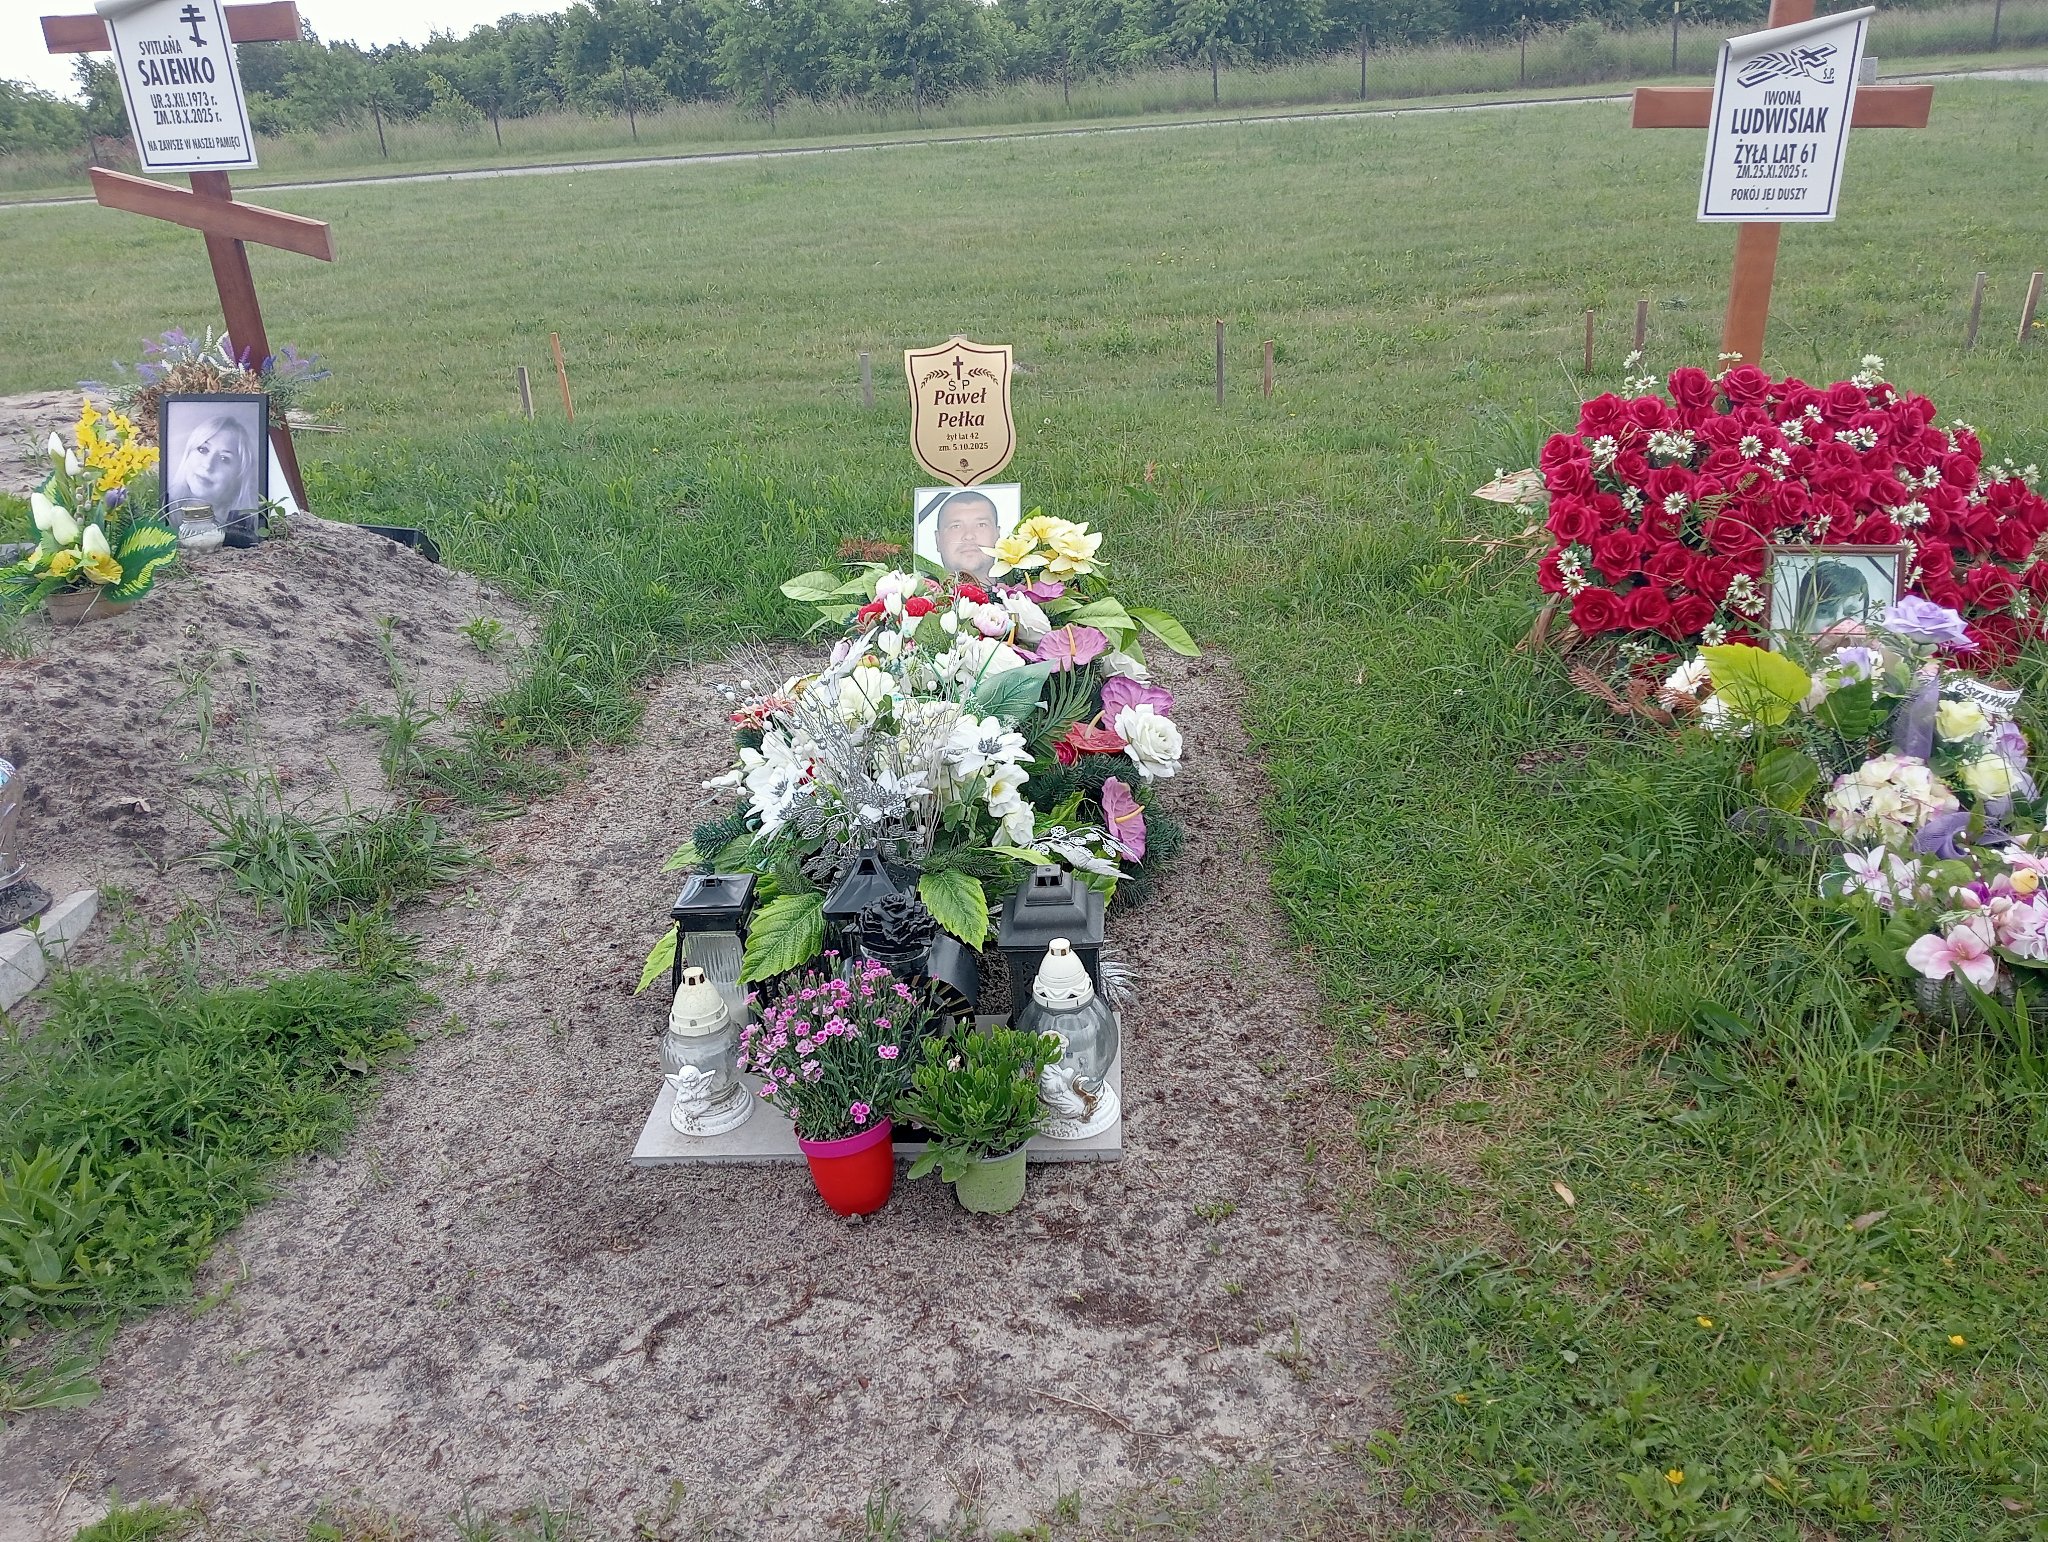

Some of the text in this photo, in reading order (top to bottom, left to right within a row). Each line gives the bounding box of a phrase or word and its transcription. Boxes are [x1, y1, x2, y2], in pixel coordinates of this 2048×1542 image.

[138, 56, 215, 86] SAIENKO
[150, 92, 218, 109] UR.3.XII.1973 r.
[1764, 90, 1801, 105] IWONA
[154, 108, 222, 125] ZM.18.X.2025 r.
[1731, 107, 1829, 134] LUDWISIAK
[147, 140, 158, 151] NA
[158, 139, 184, 151] ZAWSZE
[184, 139, 191, 150] W
[192, 138, 215, 149] NASZEJ
[1734, 139, 1817, 164] ŻYŁA LAT 61
[1736, 164, 1808, 179] ZM.25.XI.2025 r.
[1731, 185, 1808, 201] POKÓJ JEJ DUSZY
[962, 379, 970, 390] P
[934, 387, 987, 405] Paweł
[938, 411, 985, 428] Pełka
[970, 432, 979, 440] 42
